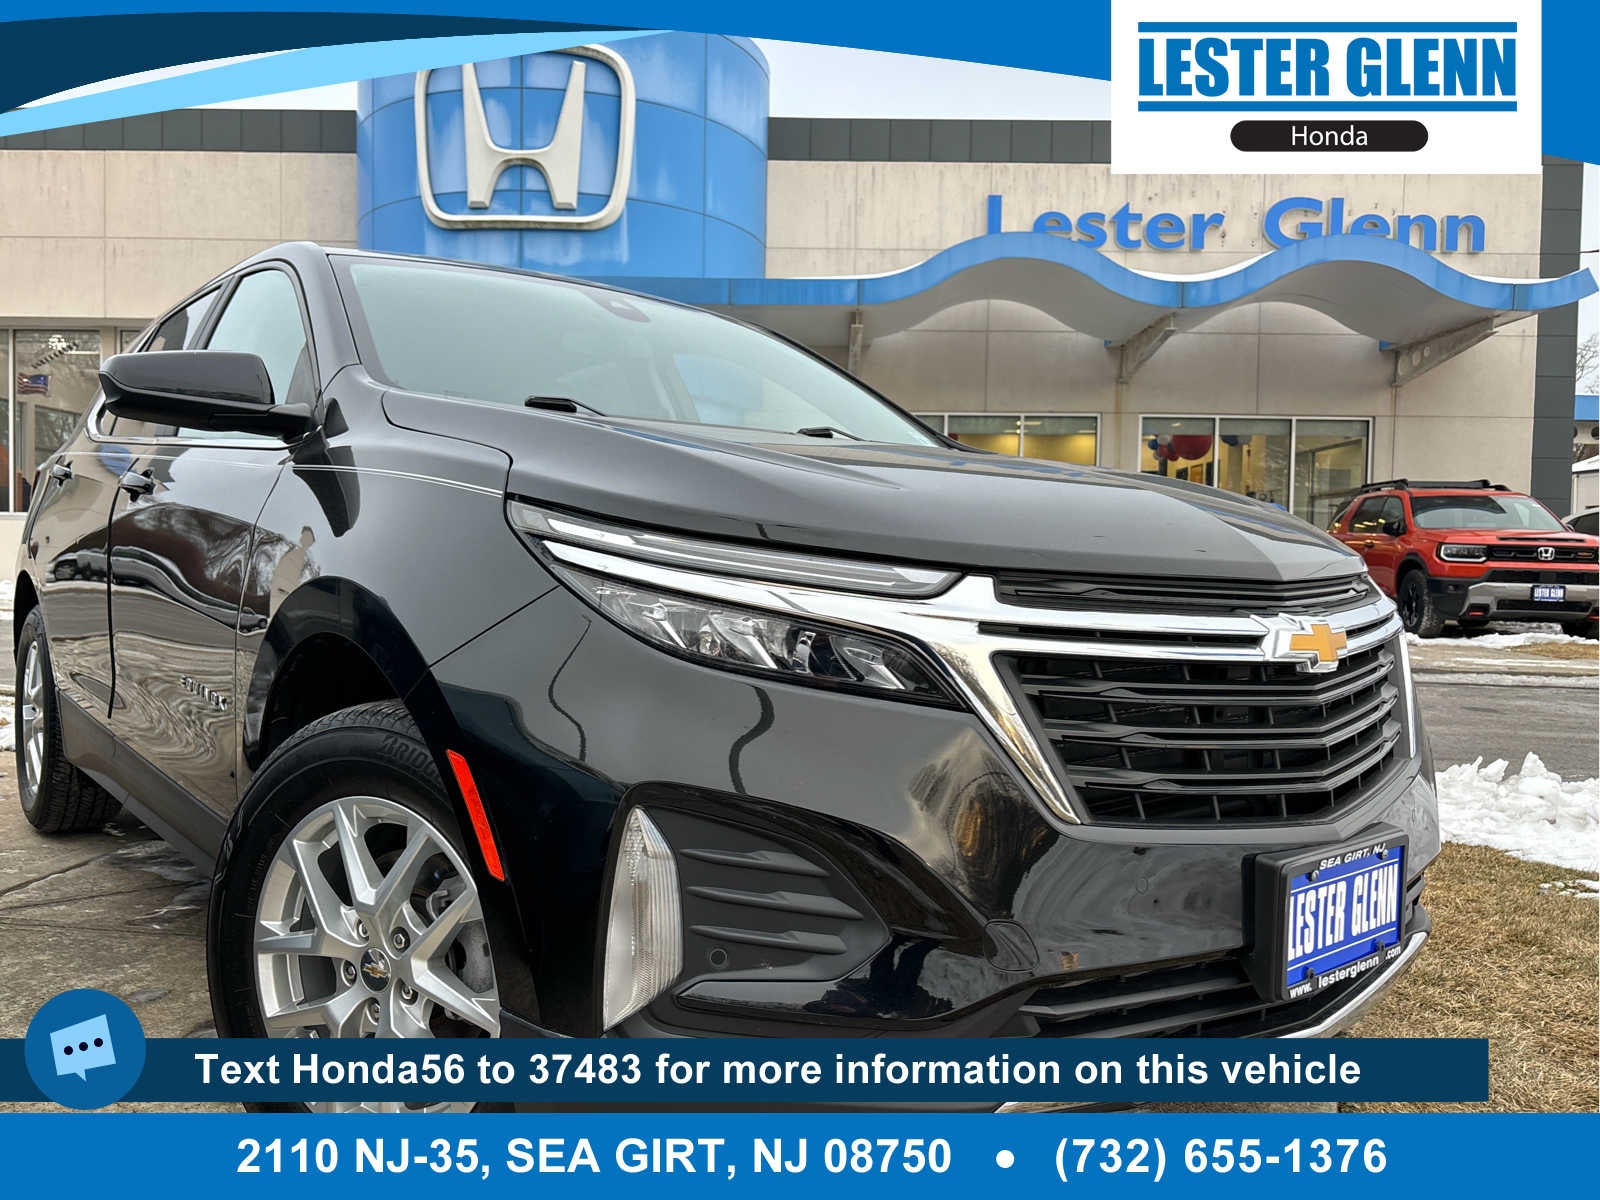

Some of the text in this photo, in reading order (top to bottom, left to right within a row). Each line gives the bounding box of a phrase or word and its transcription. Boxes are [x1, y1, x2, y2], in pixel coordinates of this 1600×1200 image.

[1263, 196, 1486, 251] Glenn
[1319, 856, 1342, 870] SEA
[1288, 864, 1399, 962] LESTER GLENN
[1318, 955, 1380, 988] lesterglenn
